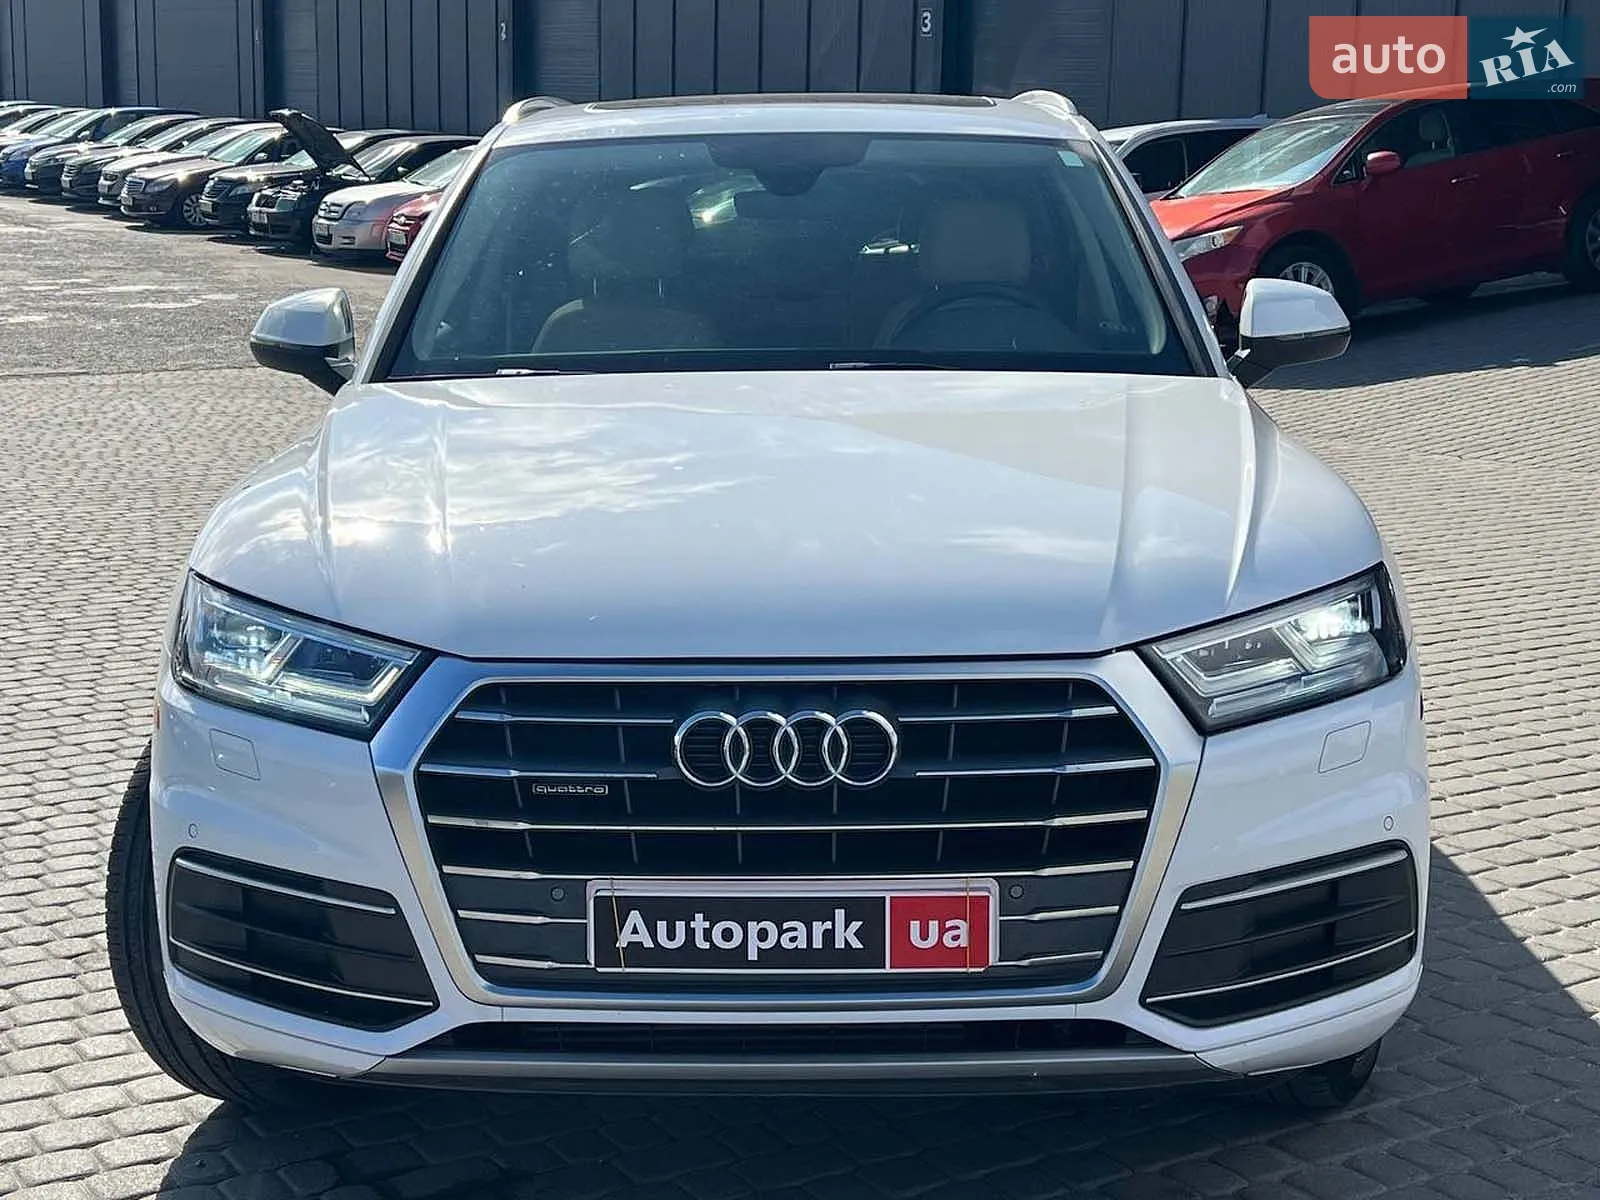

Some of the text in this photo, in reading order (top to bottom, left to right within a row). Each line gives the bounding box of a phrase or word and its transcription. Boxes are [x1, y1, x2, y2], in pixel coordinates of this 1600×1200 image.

[921, 11, 932, 33] 3
[535, 784, 605, 795] quattro
[616, 908, 968, 960] Autopark ua
